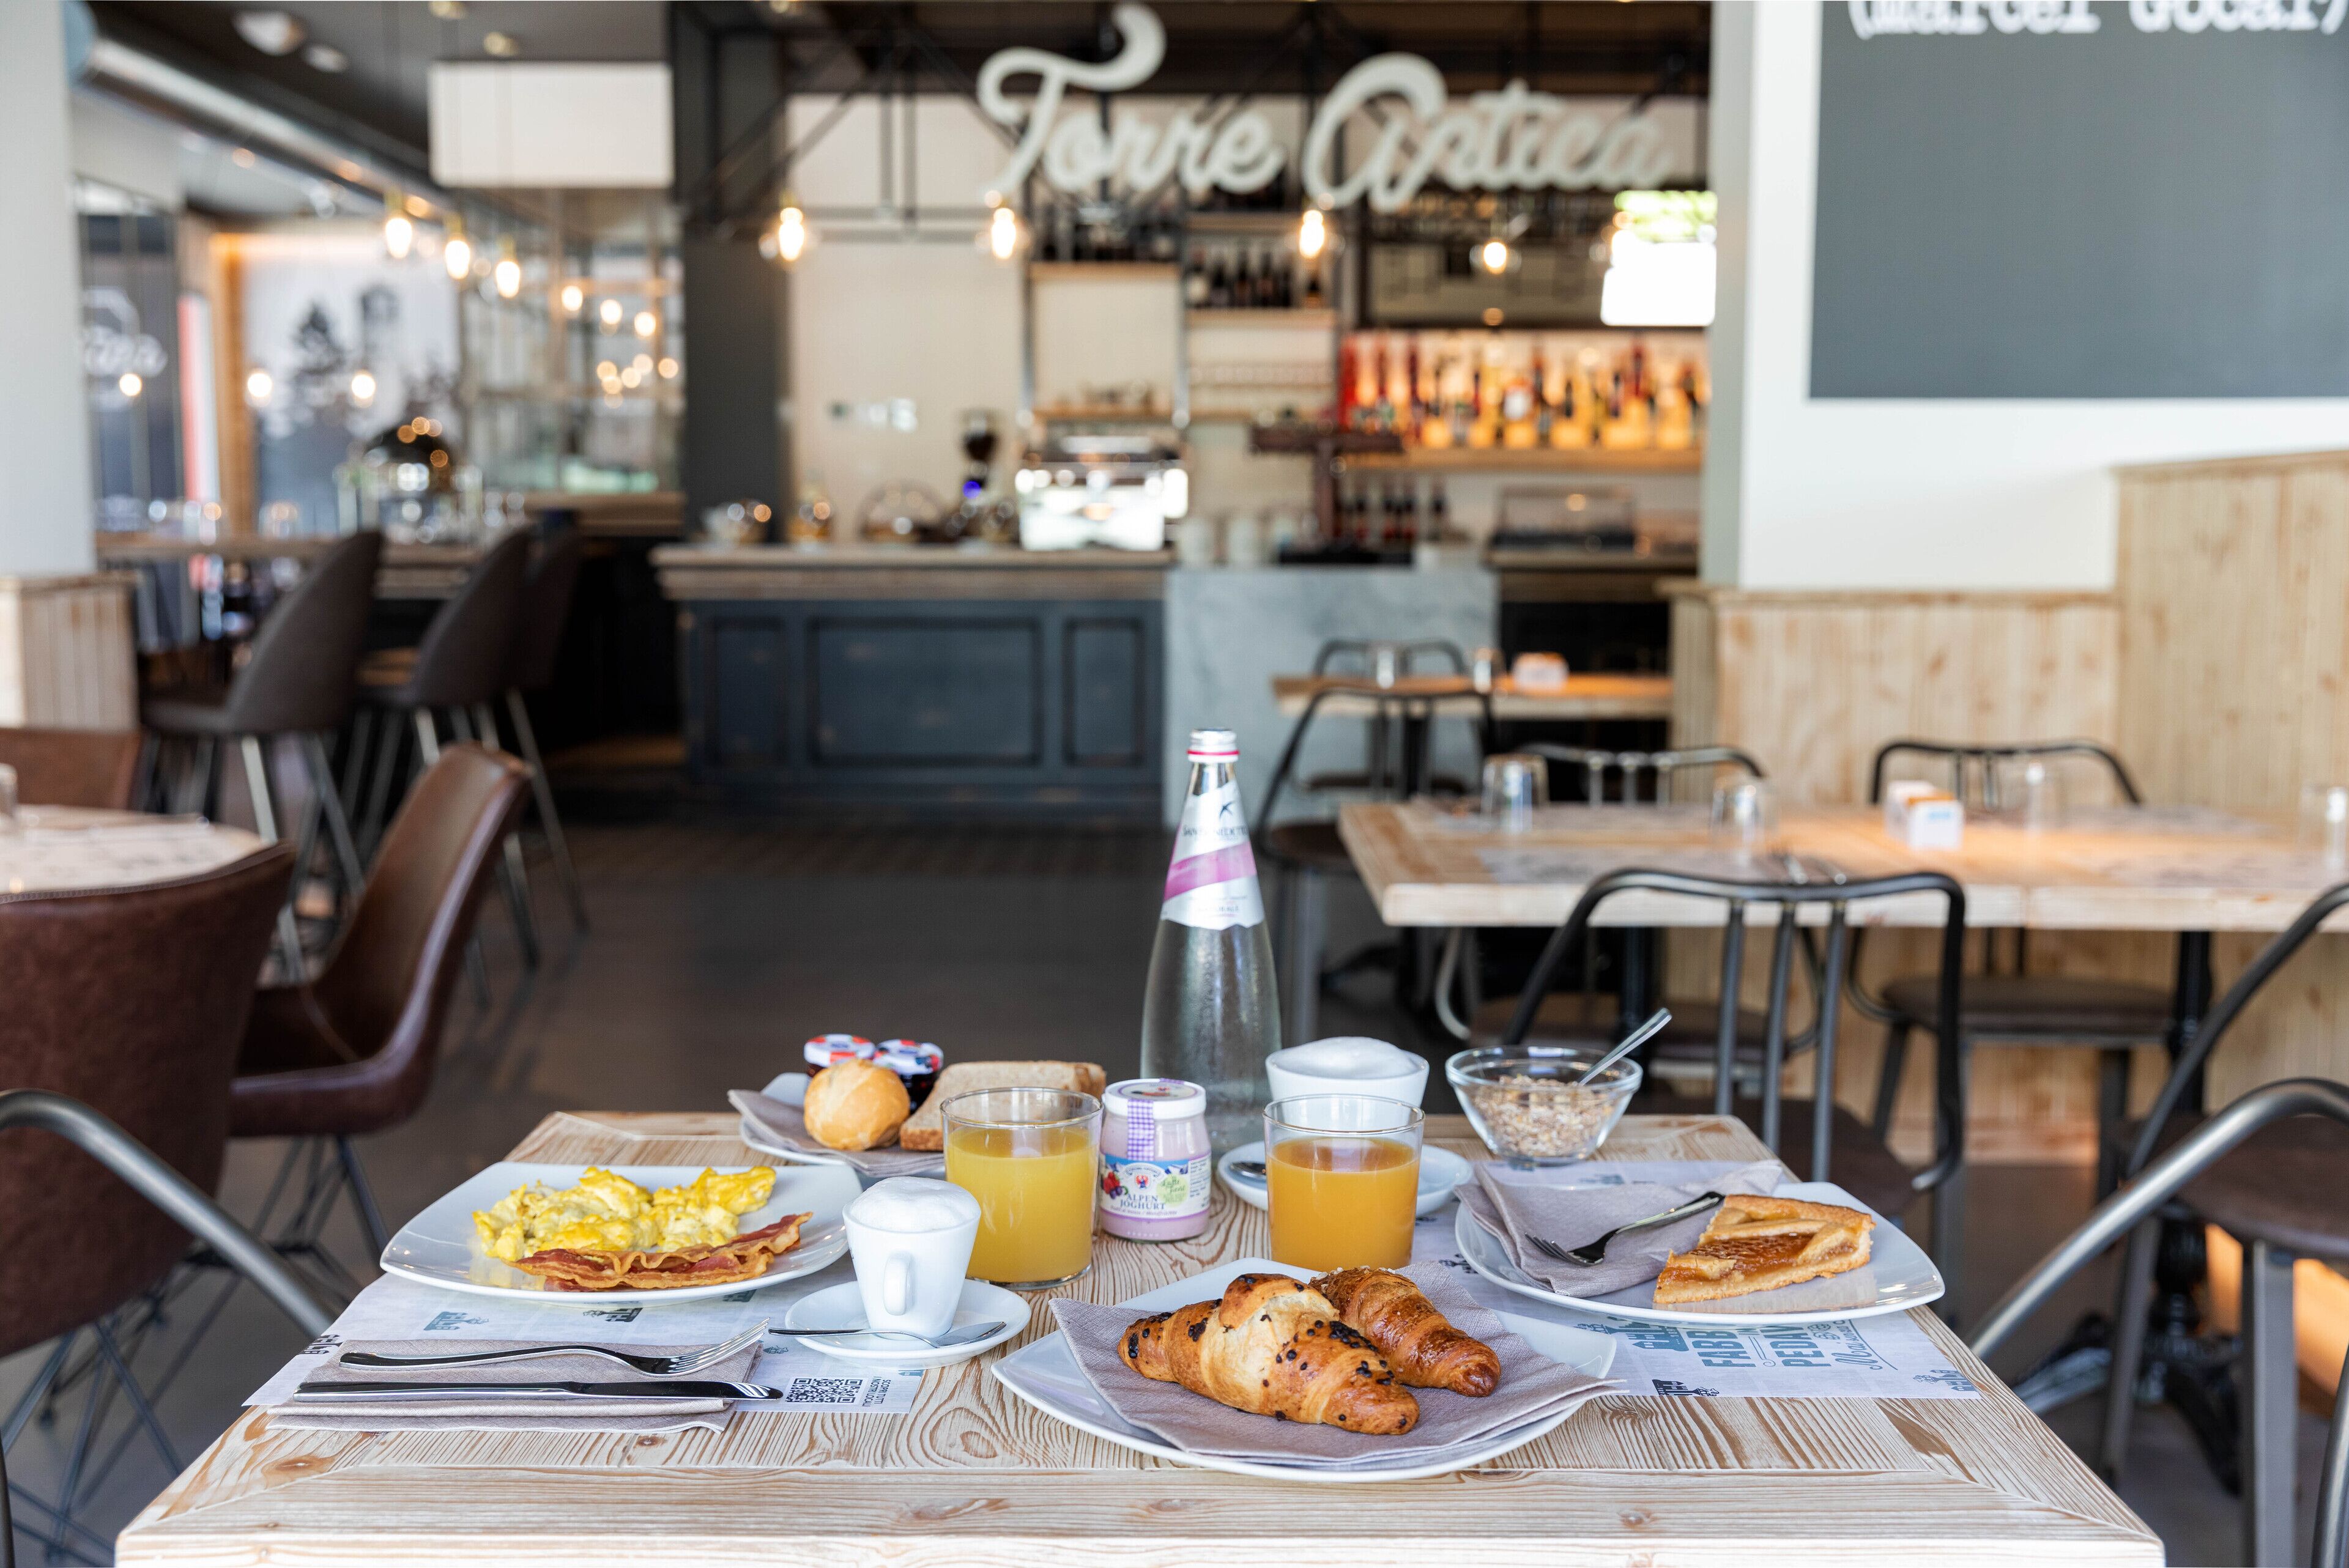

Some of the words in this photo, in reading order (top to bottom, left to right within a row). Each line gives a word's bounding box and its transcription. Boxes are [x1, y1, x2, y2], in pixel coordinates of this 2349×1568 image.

[977, 2, 1283, 194] Torre
[1120, 1199, 1166, 1210] JOGHURT
[1127, 1193, 1158, 1202] ALPEN
[1686, 1330, 1756, 1367] FABB
[1760, 1325, 1831, 1367] PEDAV
[868, 1378, 881, 1392] NOSTRI
[878, 1379, 891, 1393] SCOPRI
[862, 1393, 876, 1407] LOCALI
[874, 1394, 886, 1404] TUTTI
